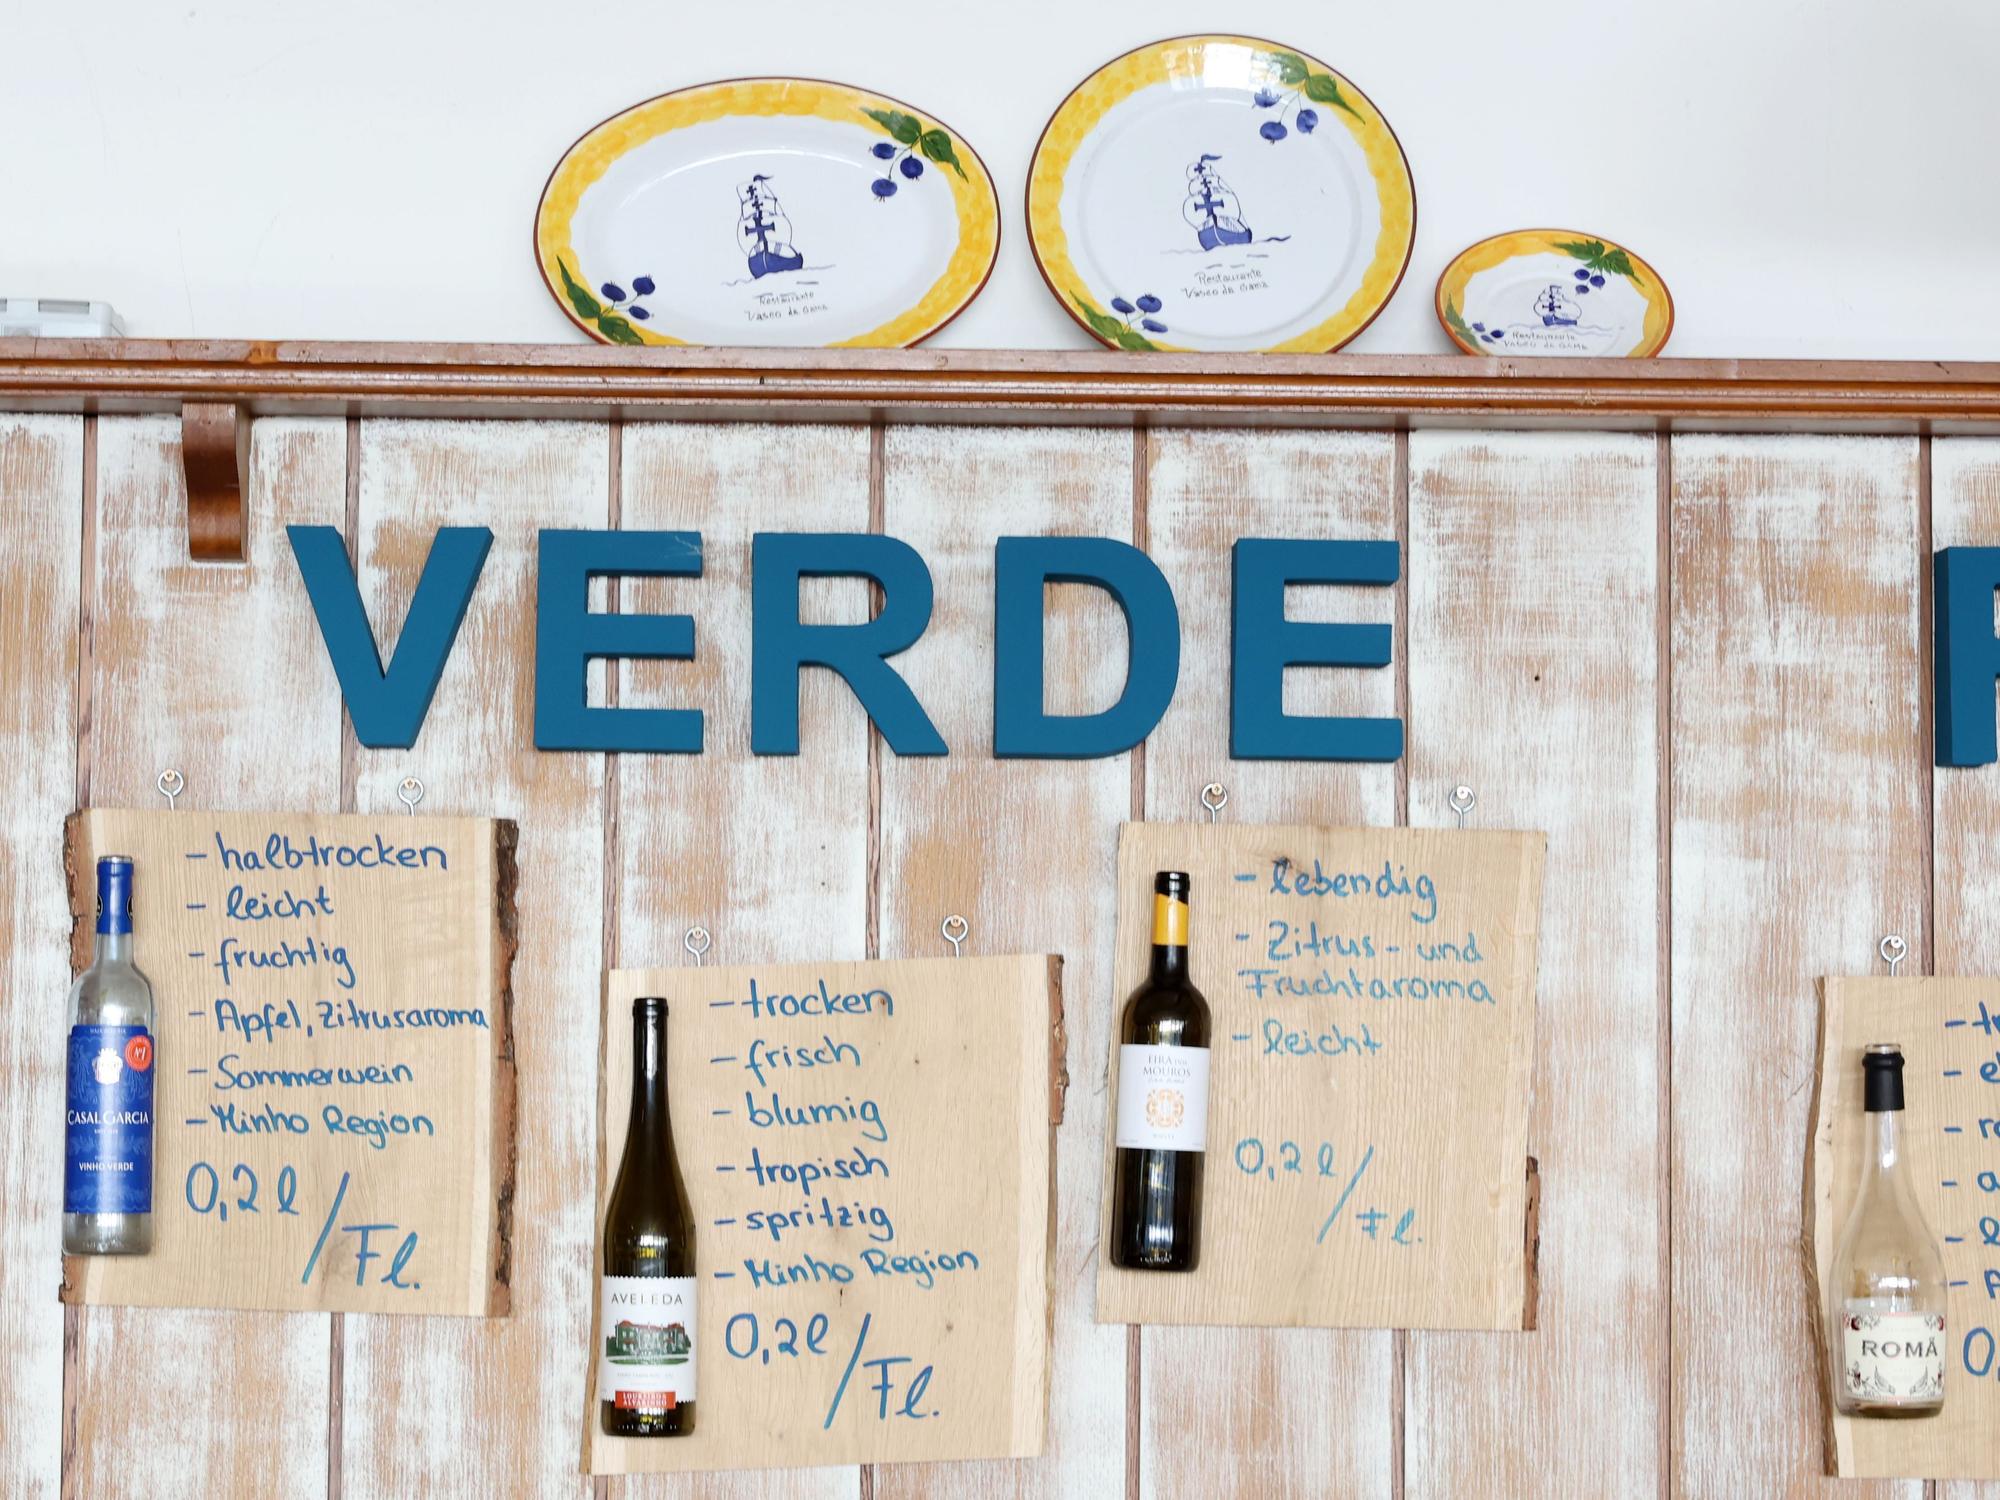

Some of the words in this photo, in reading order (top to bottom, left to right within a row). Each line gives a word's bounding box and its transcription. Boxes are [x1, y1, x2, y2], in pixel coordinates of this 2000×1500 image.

[286, 524, 1405, 762] VERDE
[215, 832, 448, 871] halbtrocken
[226, 885, 335, 921] leicht
[1270, 859, 1437, 923] lebendig
[214, 937, 356, 988] fruchtig
[1417, 934, 1483, 962] und
[741, 979, 894, 1018] trocken
[1237, 968, 1496, 1004] Fruchtaroma
[1263, 1019, 1382, 1056] leicht
[214, 1054, 413, 1089] Sommerwein
[745, 1035, 861, 1087] frisch
[1143, 1067, 1191, 1077] MOUROS
[68, 1110, 100, 1125] CASAL
[103, 1110, 149, 1126] GARCIA
[322, 1105, 434, 1149] Region
[745, 1092, 888, 1142] blumig
[79, 1162, 106, 1171] VINHO
[107, 1162, 134, 1172] VERDE
[746, 1148, 889, 1196] tropisch
[746, 1197, 894, 1242] spritzig
[860, 1248, 979, 1290] Region
